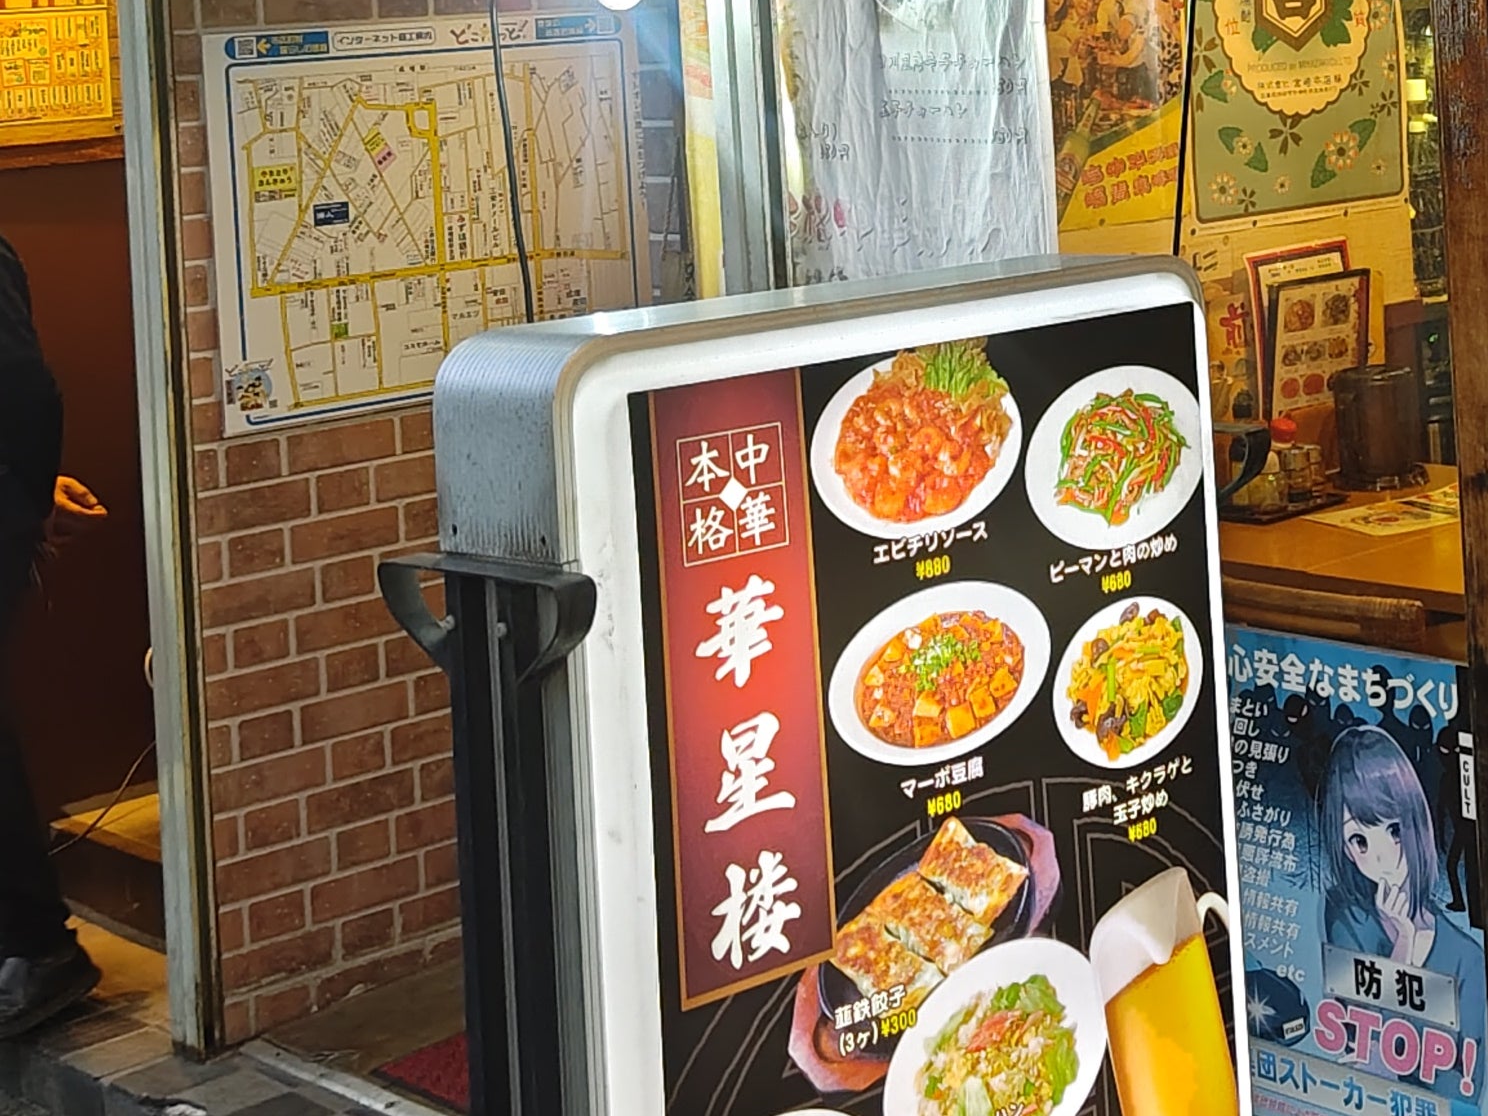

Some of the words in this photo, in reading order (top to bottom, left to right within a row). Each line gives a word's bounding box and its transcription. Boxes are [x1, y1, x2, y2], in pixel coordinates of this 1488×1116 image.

[873, 520, 989, 565] エビチリソース
[1050, 533, 1178, 584] ピーマンと肉の炒め
[915, 555, 951, 580] ¥880
[1102, 570, 1132, 594] ¥680
[1231, 736, 1290, 764] の見張り
[696, 575, 804, 971] 華星楼
[900, 756, 984, 799] マーボ豆腐
[1462, 760, 1473, 815] CULT
[927, 790, 962, 818] ¥680
[1113, 789, 1169, 826] 玉子炒め
[1127, 817, 1157, 843] ¥680
[1276, 963, 1306, 982] etc
[1353, 957, 1427, 1014] 防犯
[881, 1008, 918, 1038] ¥300
[1314, 996, 1478, 1100] STOP!
[1251, 1047, 1438, 1116] 団ストーカー犯罪
